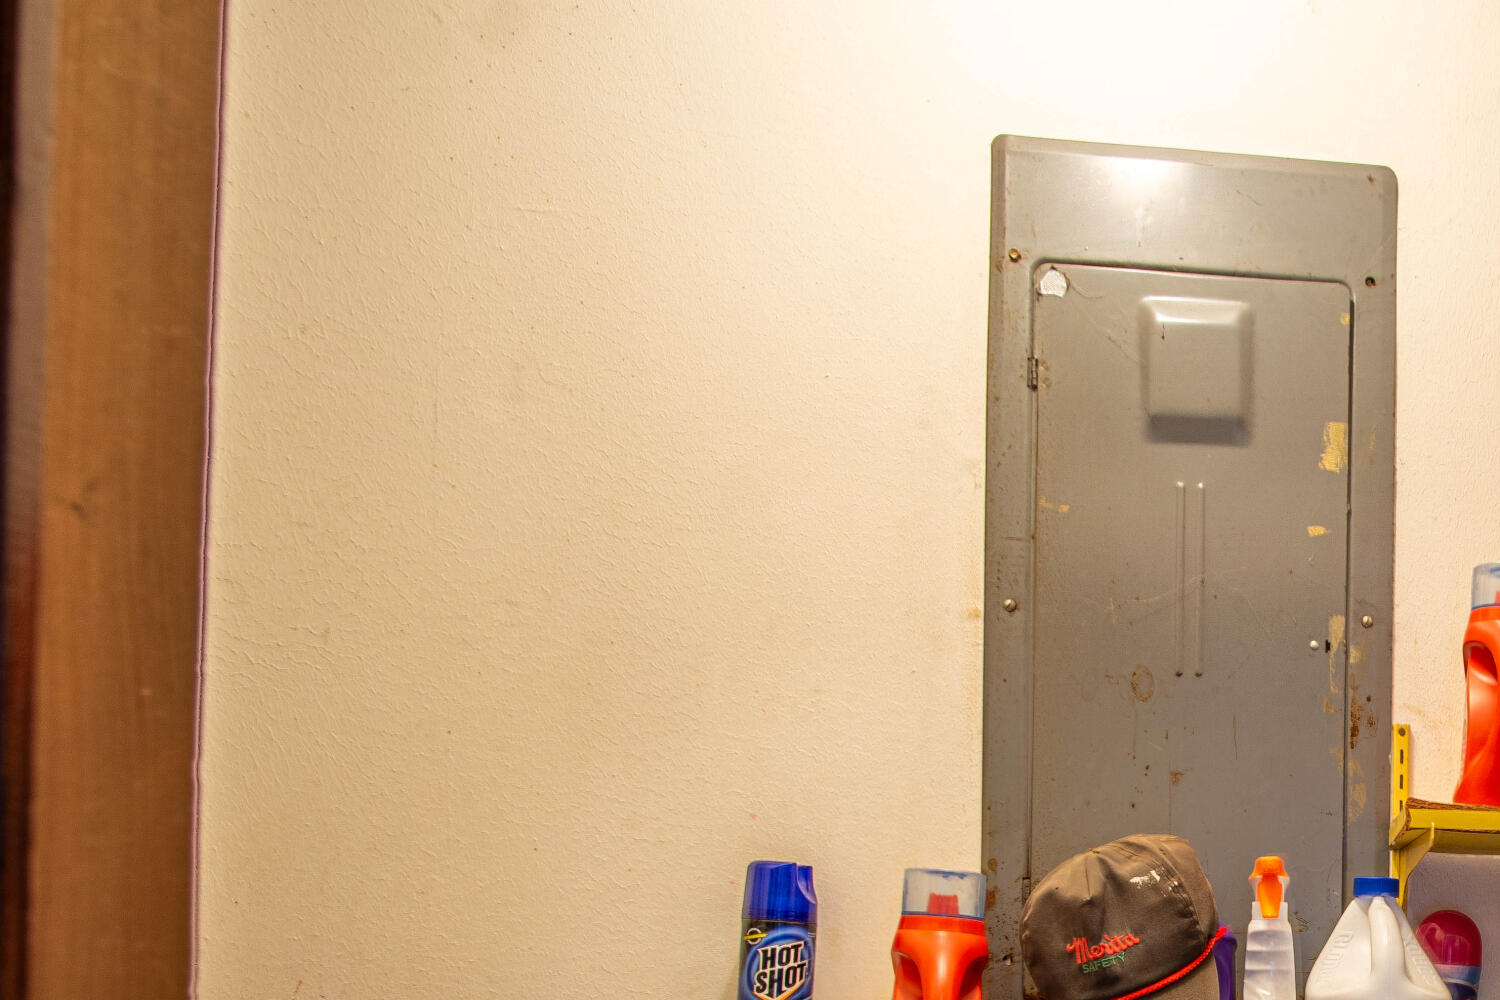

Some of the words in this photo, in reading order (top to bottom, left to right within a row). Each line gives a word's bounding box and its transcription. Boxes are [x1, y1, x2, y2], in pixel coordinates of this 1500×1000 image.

[757, 942, 804, 971] HOT
[1066, 933, 1140, 965] Merita
[1082, 952, 1125, 973] SAFETY
[754, 961, 808, 998] SHOT
